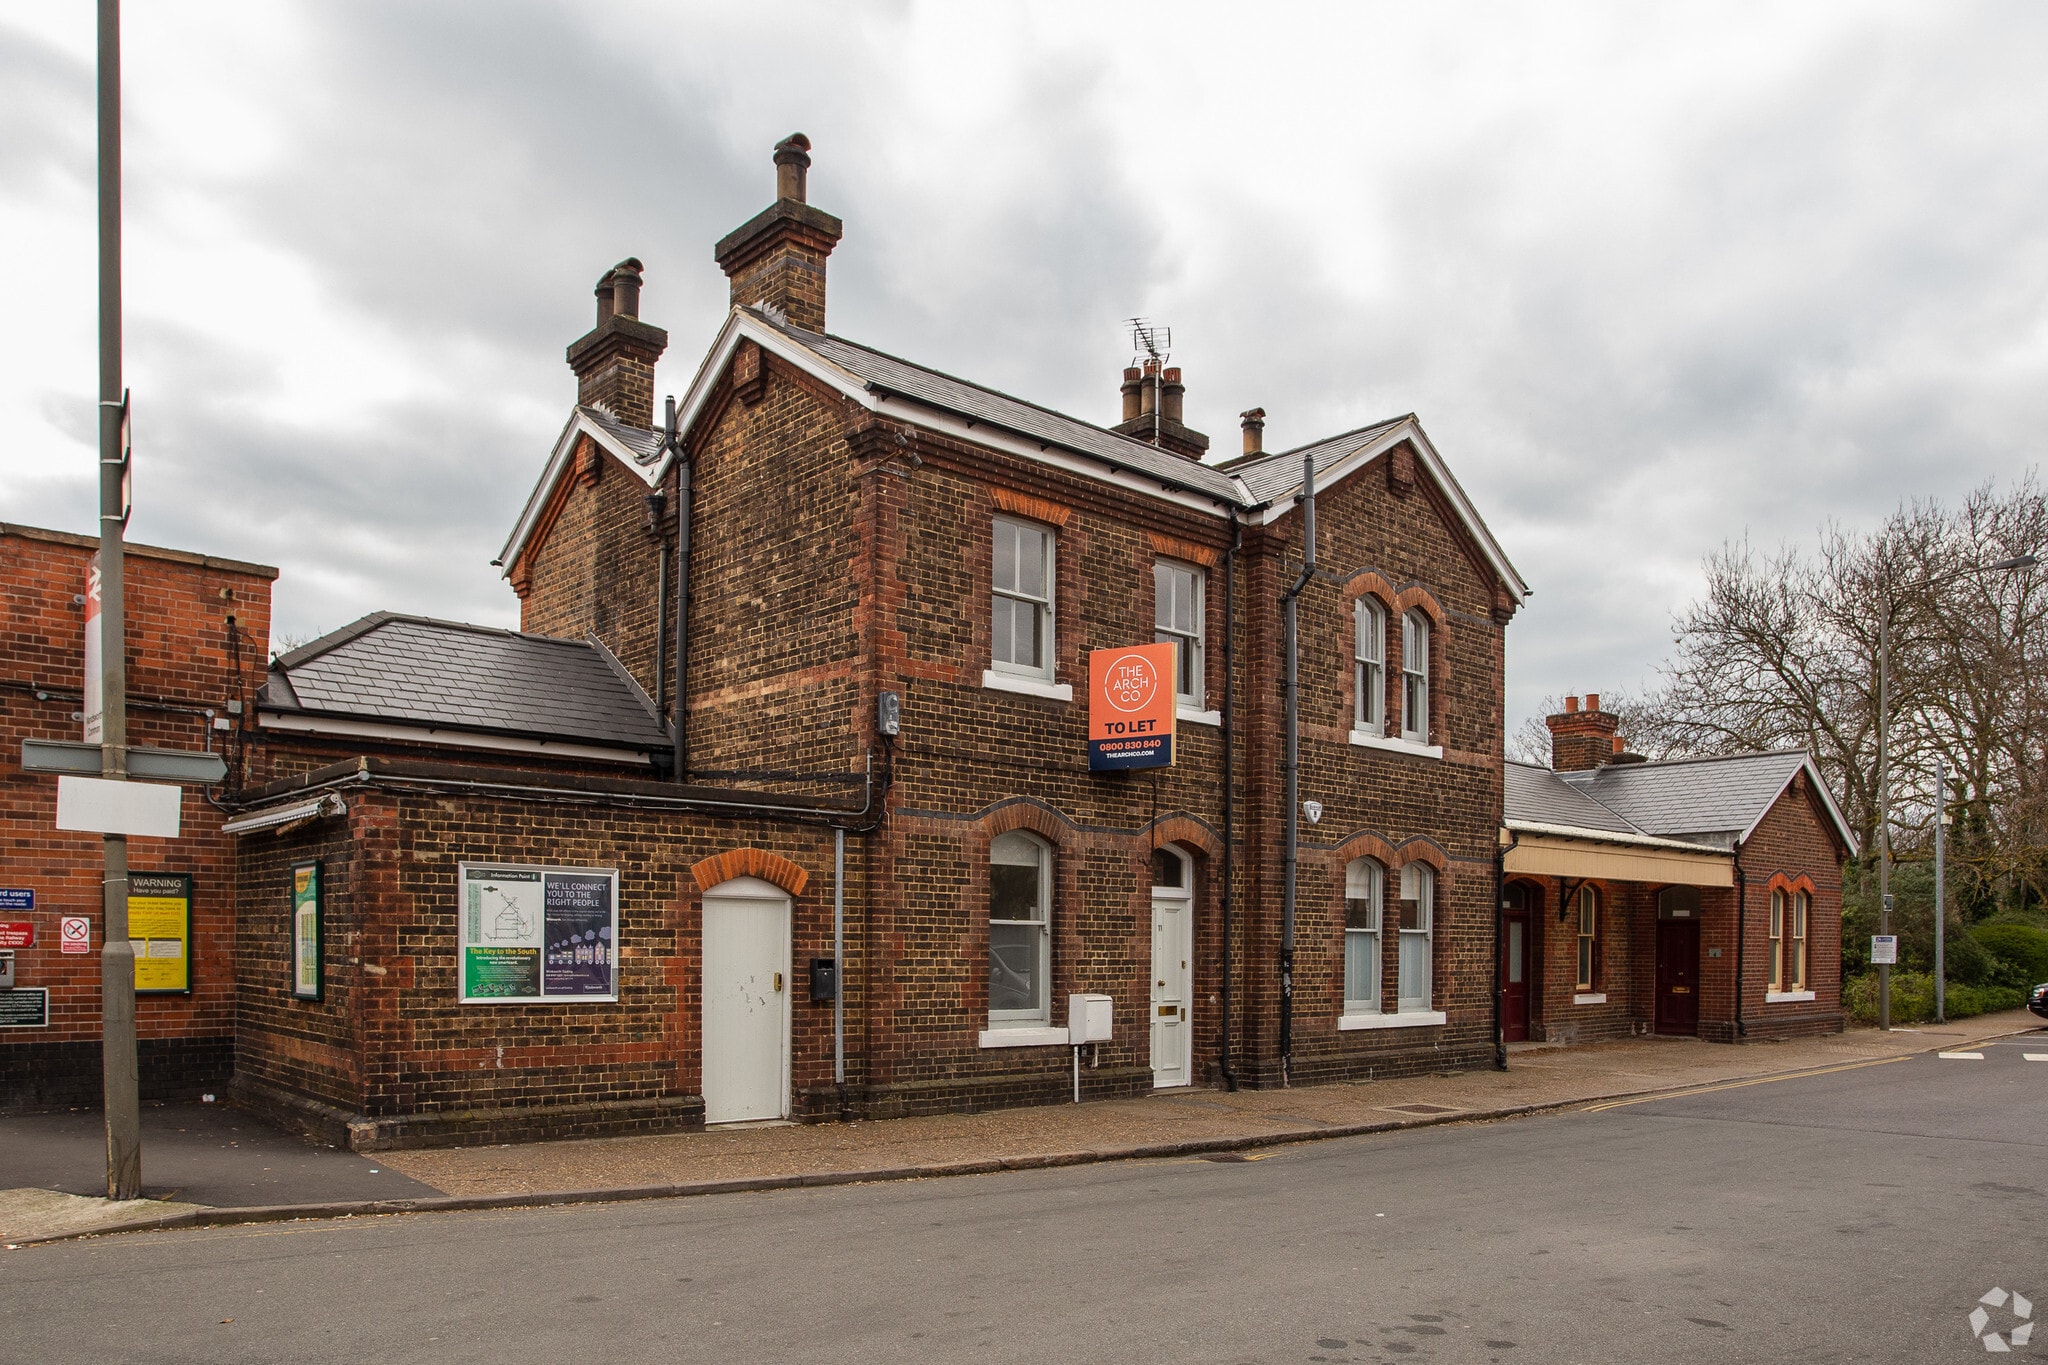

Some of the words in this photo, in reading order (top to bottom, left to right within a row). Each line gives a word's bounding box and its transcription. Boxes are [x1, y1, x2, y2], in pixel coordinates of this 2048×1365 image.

[1118, 665, 1143, 678] THE
[1113, 677, 1149, 691] ARCH
[1120, 690, 1140, 702] CO
[1104, 722, 1126, 734] TO
[1128, 720, 1156, 732] LET
[1100, 742, 1123, 752] 0800
[1125, 740, 1142, 750] 830
[1144, 739, 1162, 748] 840
[1106, 750, 1154, 758] THEARCHCO.COM
[133, 878, 182, 888] WARNING
